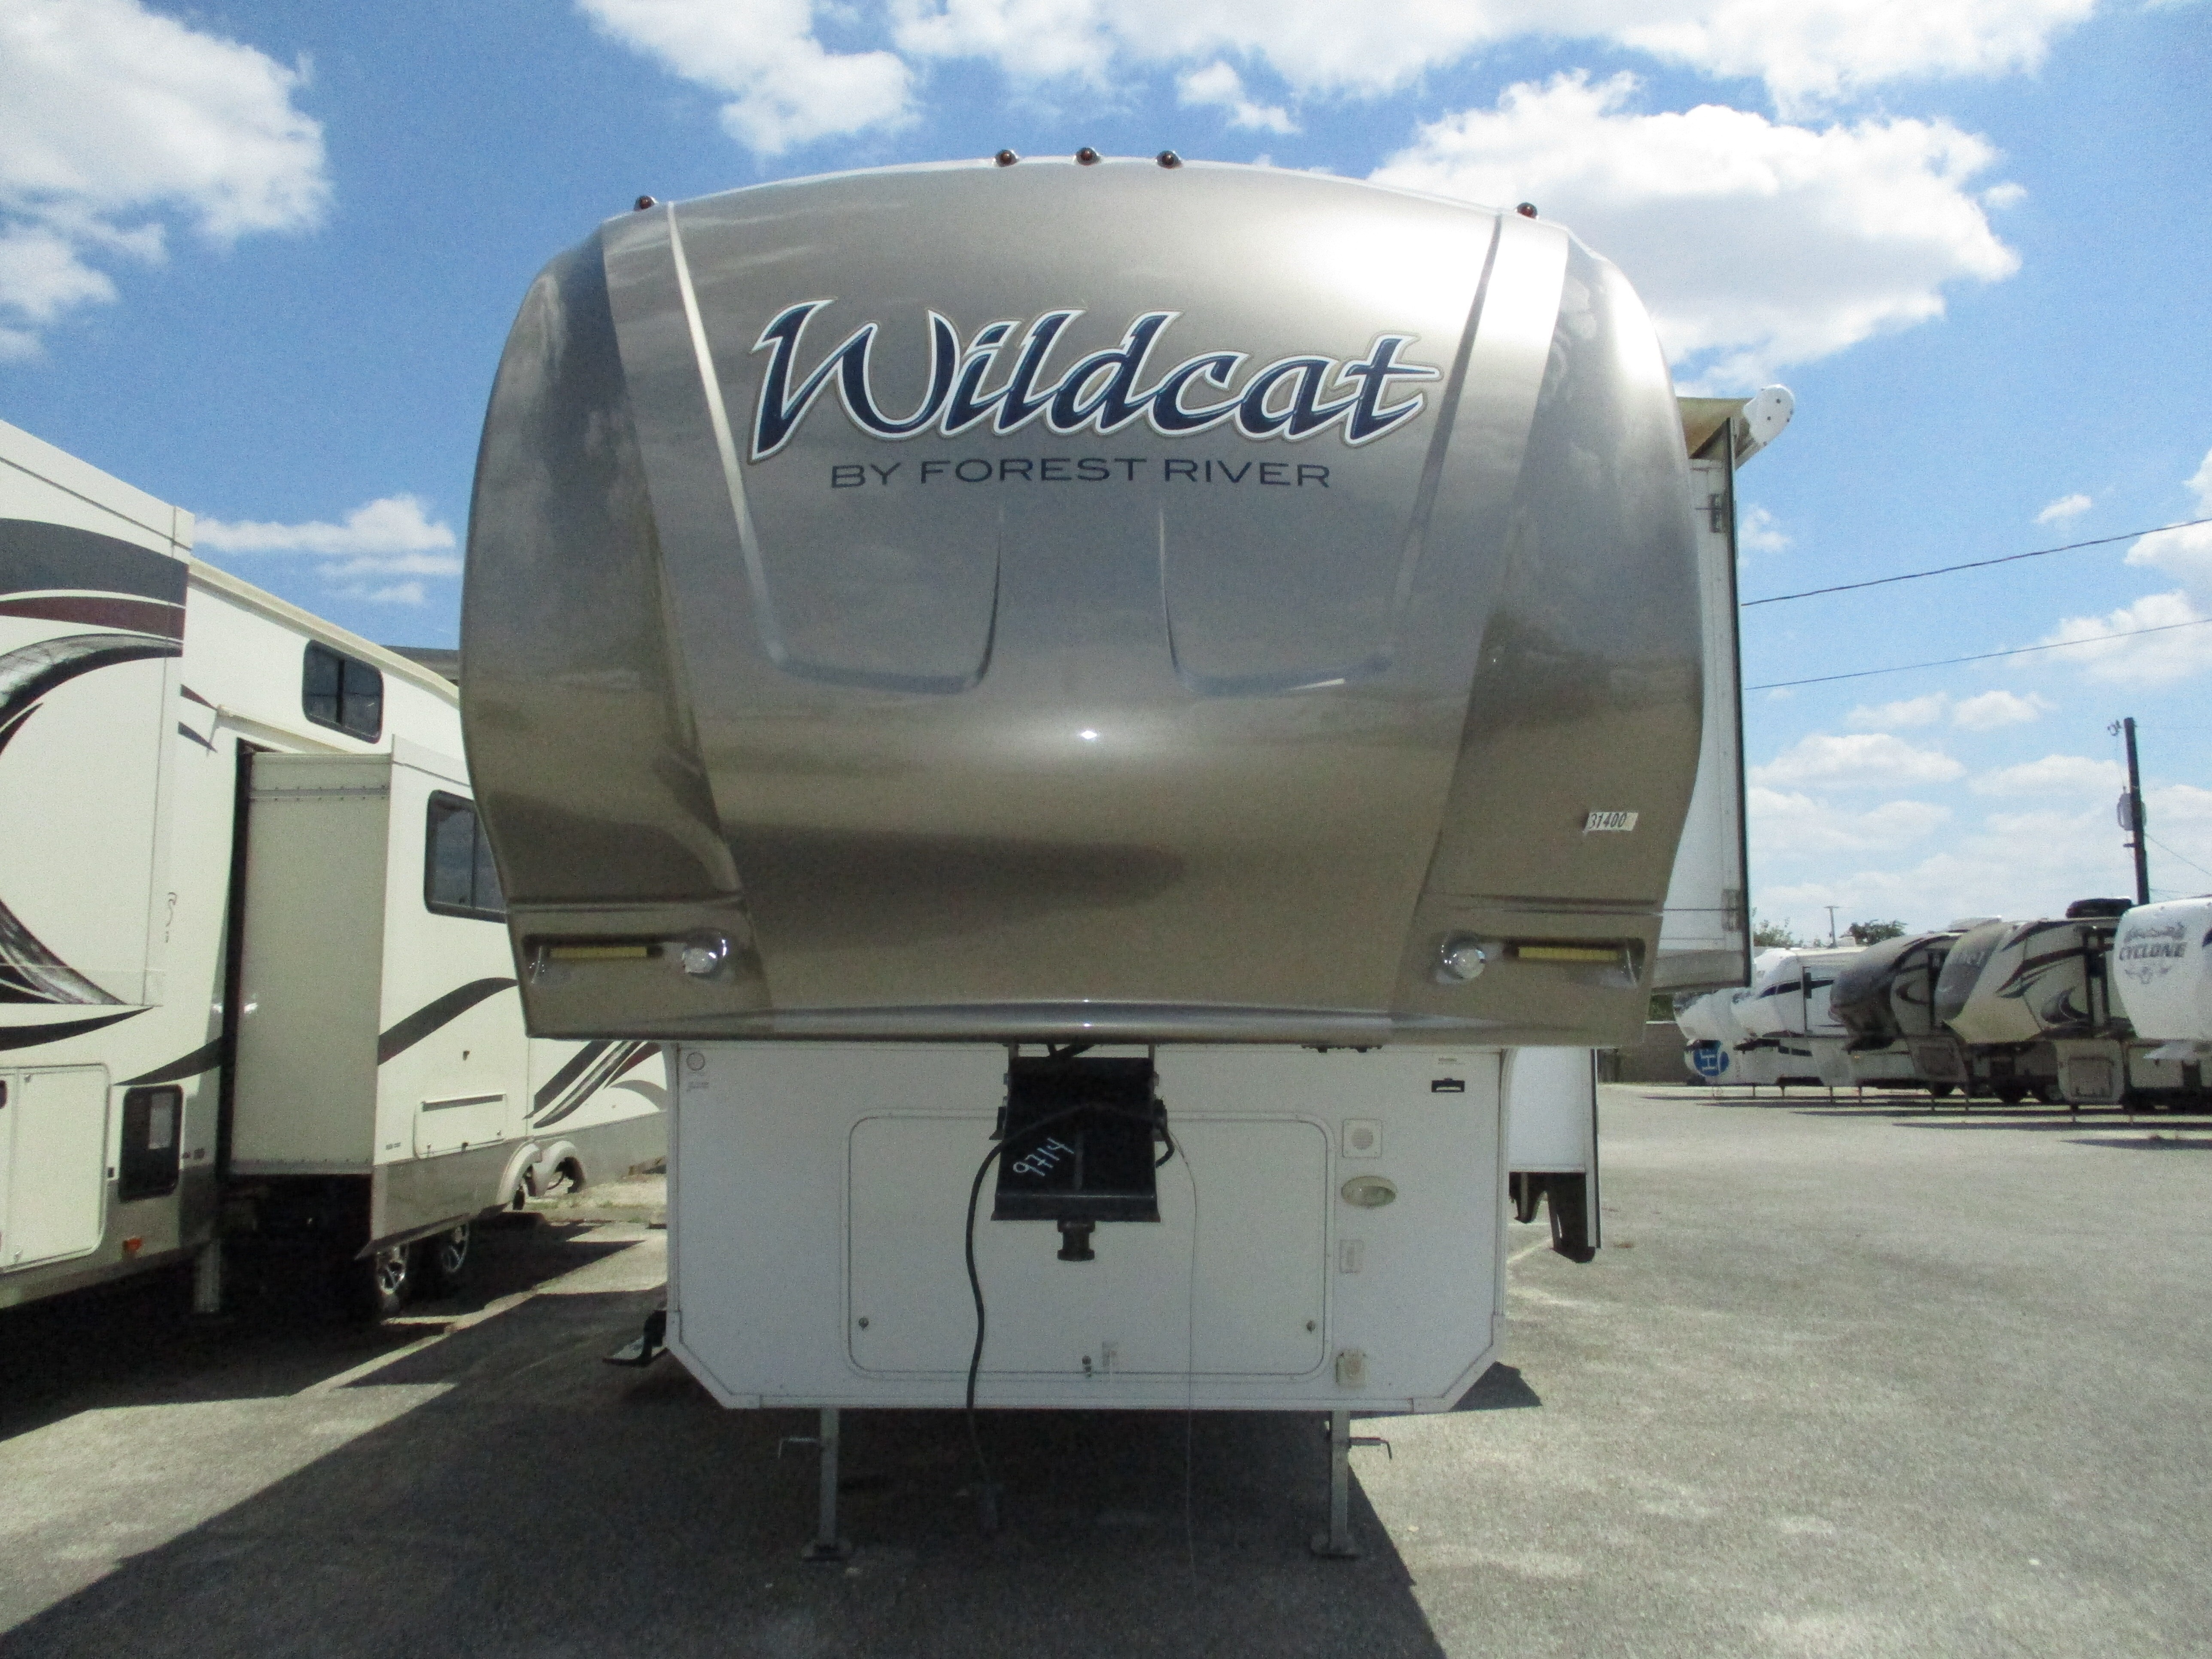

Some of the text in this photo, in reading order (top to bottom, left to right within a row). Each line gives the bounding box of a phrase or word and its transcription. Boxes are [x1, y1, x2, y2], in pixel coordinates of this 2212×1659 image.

[750, 299, 1440, 462] Wildcat
[831, 457, 1330, 488] BY FOREST RIVER
[1589, 812, 1628, 829] 31400
[2119, 942, 2188, 960] CYCLONE
[1012, 1136, 1074, 1177] 9714
